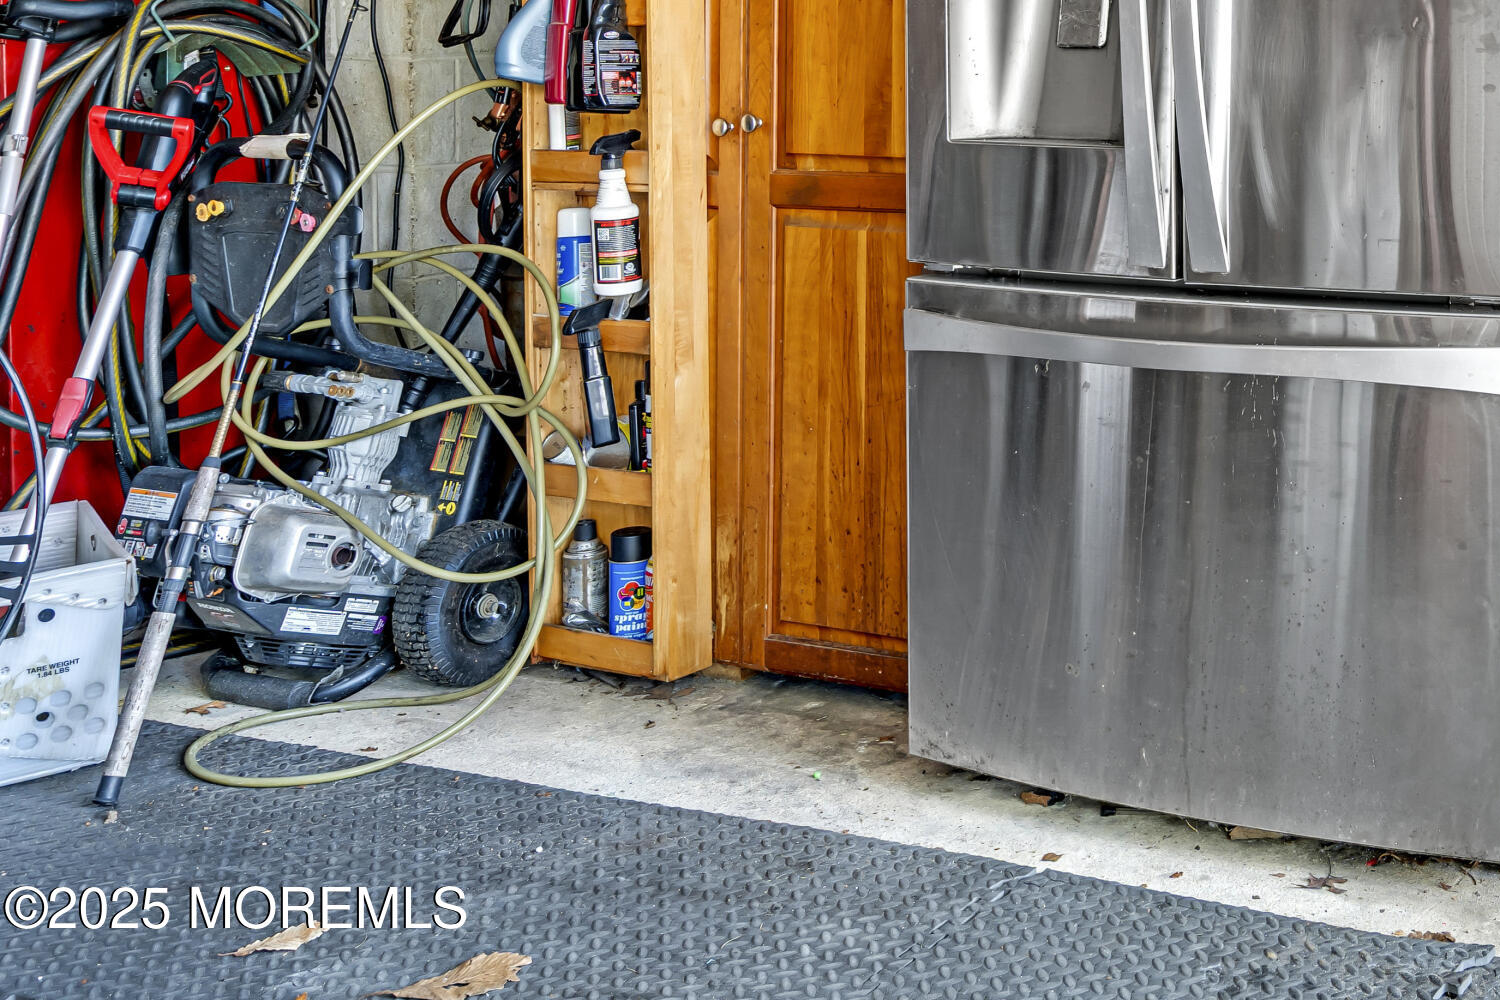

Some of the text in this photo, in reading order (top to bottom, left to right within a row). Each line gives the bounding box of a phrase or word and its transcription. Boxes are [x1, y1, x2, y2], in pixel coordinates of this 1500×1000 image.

[26, 657, 81, 675] TARE WEIGHT
[37, 666, 70, 679] 1.84 LBS
